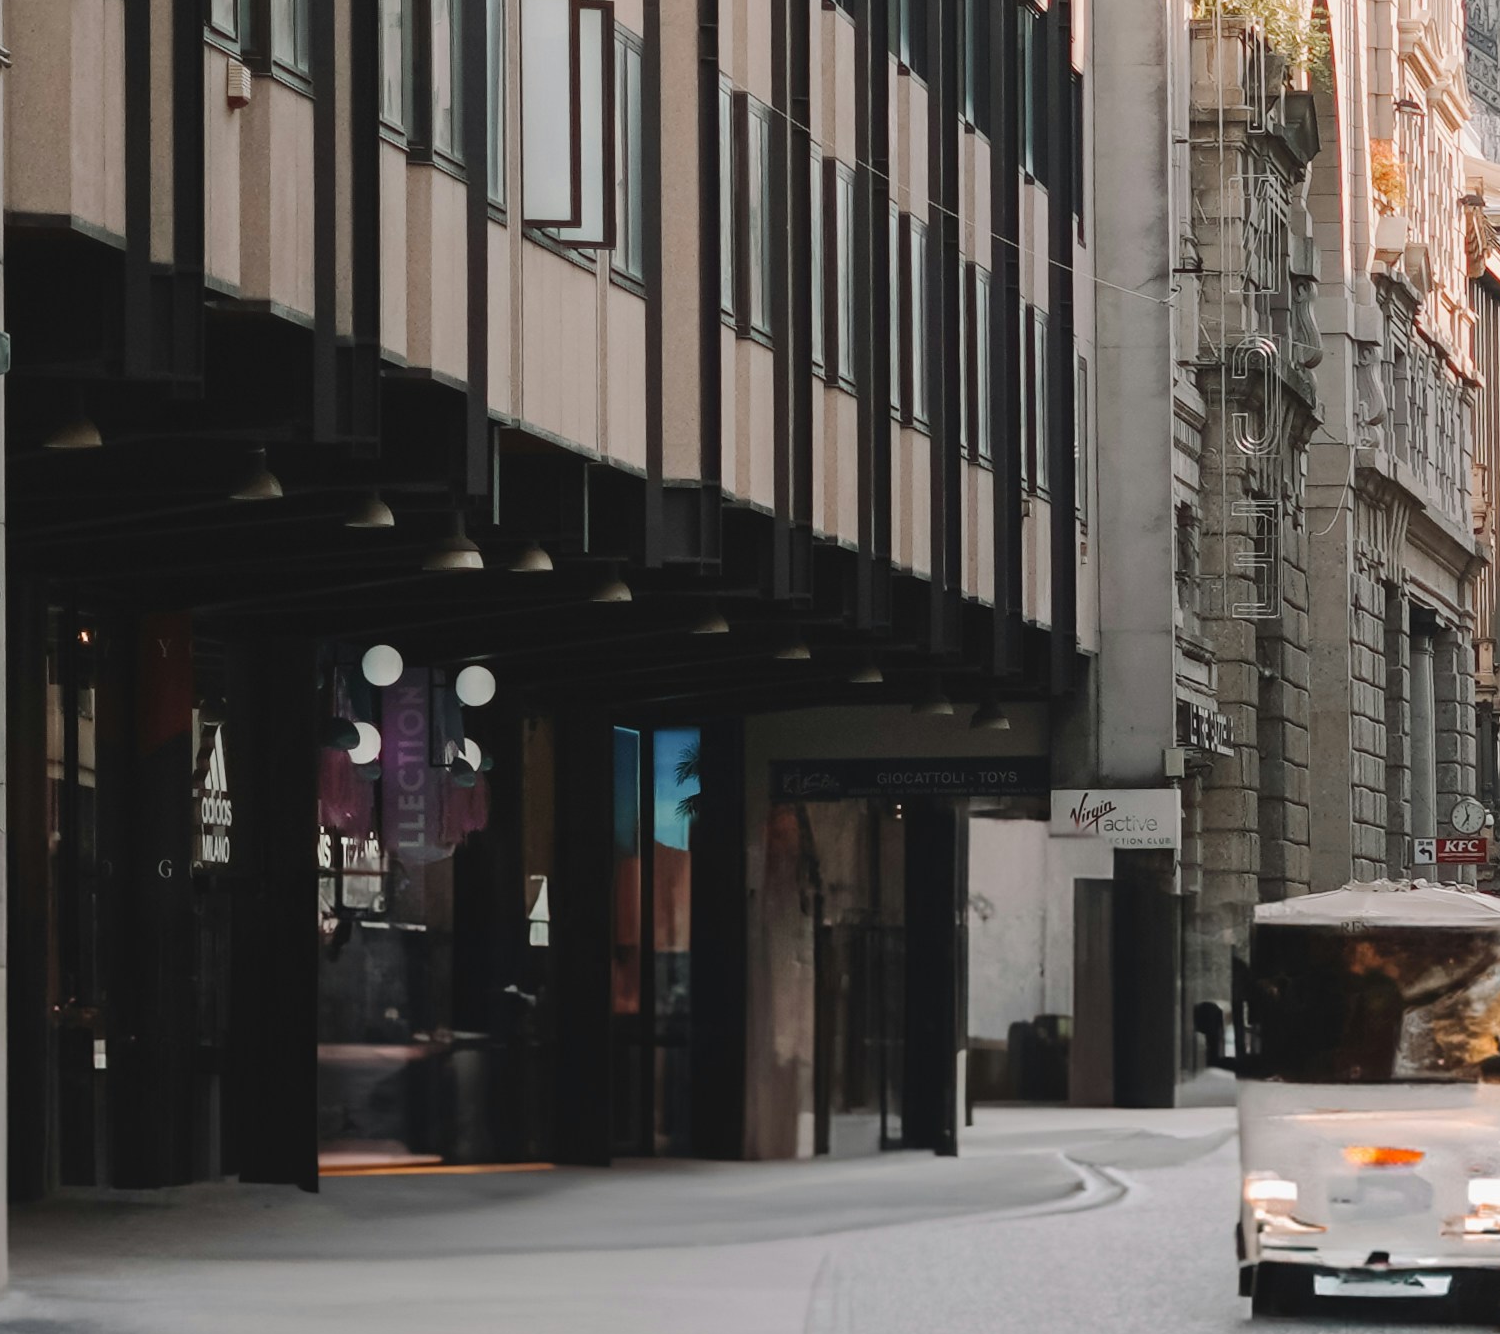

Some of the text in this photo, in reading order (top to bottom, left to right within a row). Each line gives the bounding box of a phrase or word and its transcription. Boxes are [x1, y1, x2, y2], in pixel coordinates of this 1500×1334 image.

[876, 772, 967, 785] GIOCATTOLI
[979, 771, 1017, 784] TOYS
[202, 796, 232, 827] adidas
[1070, 793, 1117, 834] Virgin
[1103, 816, 1158, 832] active
[202, 833, 231, 864] MILANO
[1444, 840, 1478, 852] KFC
